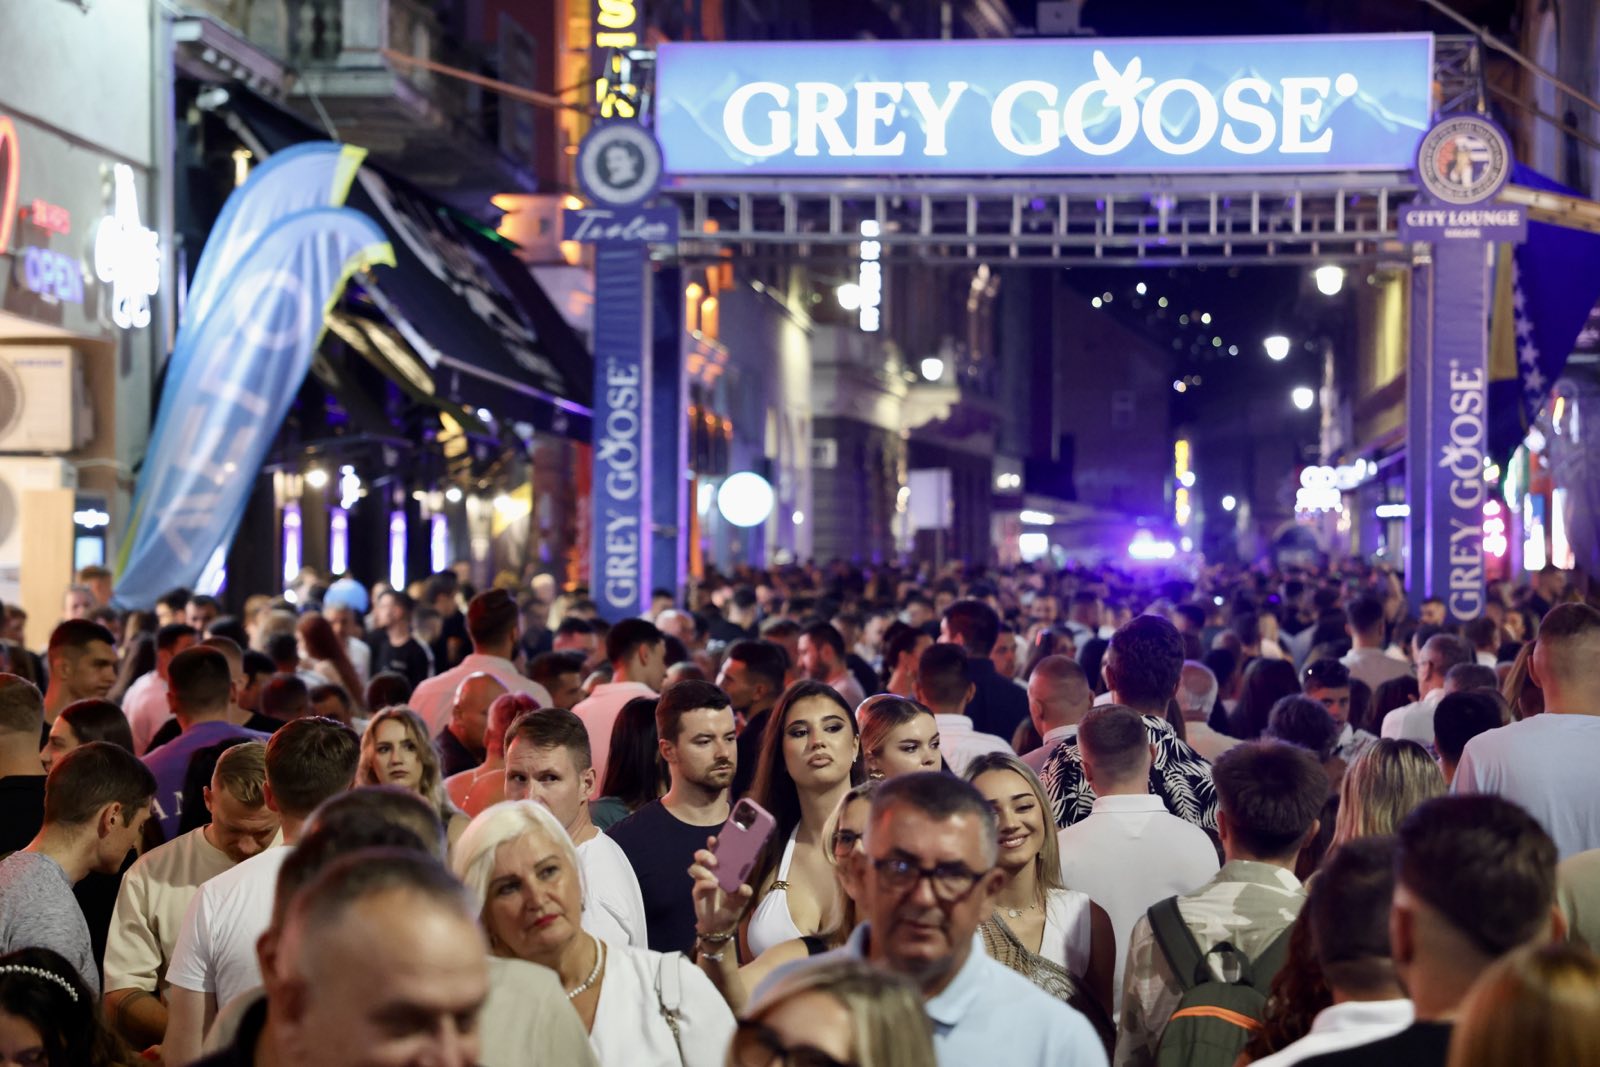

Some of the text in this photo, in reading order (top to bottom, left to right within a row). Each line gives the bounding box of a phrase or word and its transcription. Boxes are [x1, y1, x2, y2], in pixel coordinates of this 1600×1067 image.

[723, 77, 1334, 157] GREY GOOSE
[1406, 210, 1520, 227] CITY LOUNGE
[605, 363, 639, 608] GREY GOOSE
[1449, 366, 1484, 621] GREY GOOSE
